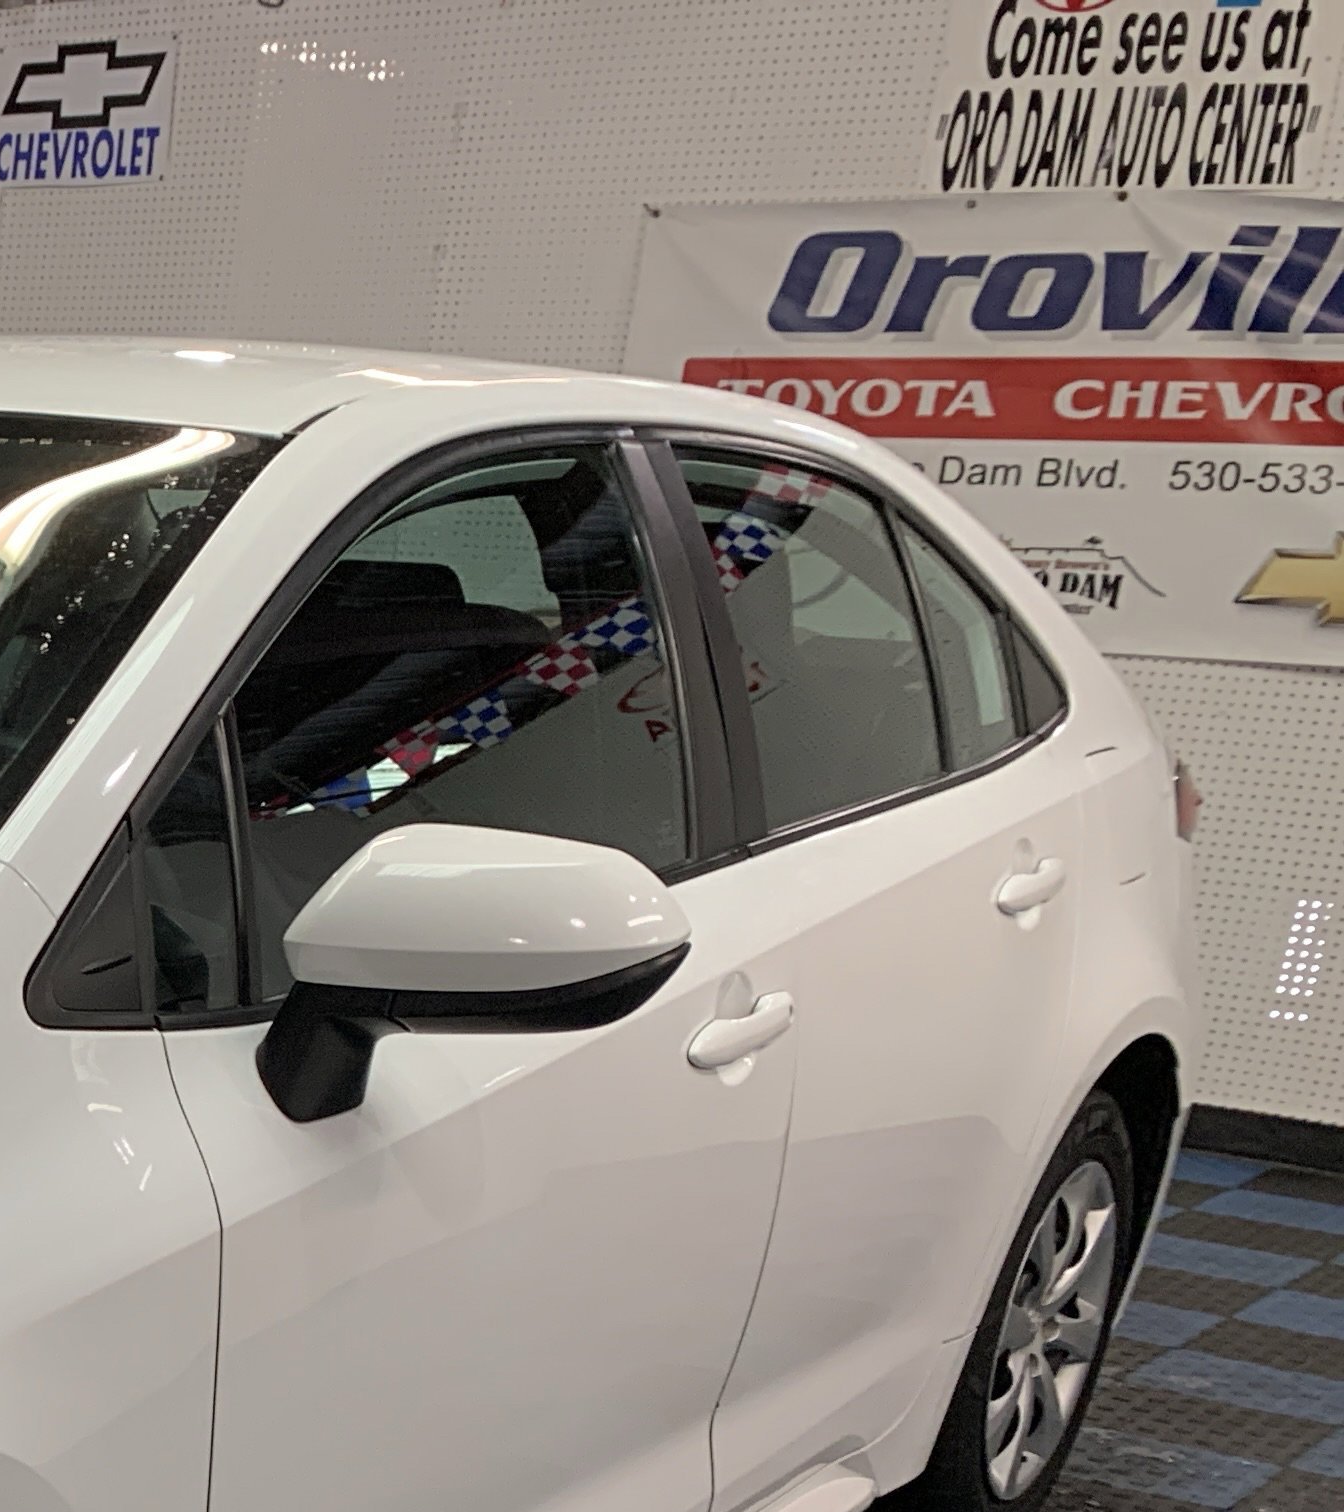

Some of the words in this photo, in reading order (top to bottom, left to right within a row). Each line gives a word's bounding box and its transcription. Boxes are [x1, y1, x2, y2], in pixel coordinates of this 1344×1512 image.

[986, 0, 1103, 79] Come
[1113, 11, 1189, 75] see
[1200, 9, 1252, 73] us
[935, 87, 1014, 193] "ORO
[1011, 88, 1097, 188] DAM
[1092, 82, 1189, 189] AUTO
[1188, 82, 1323, 187] CENTER"
[938, 455, 1023, 488] Dam
[1036, 457, 1128, 490] Blvd.
[1059, 572, 1124, 610] DAM
